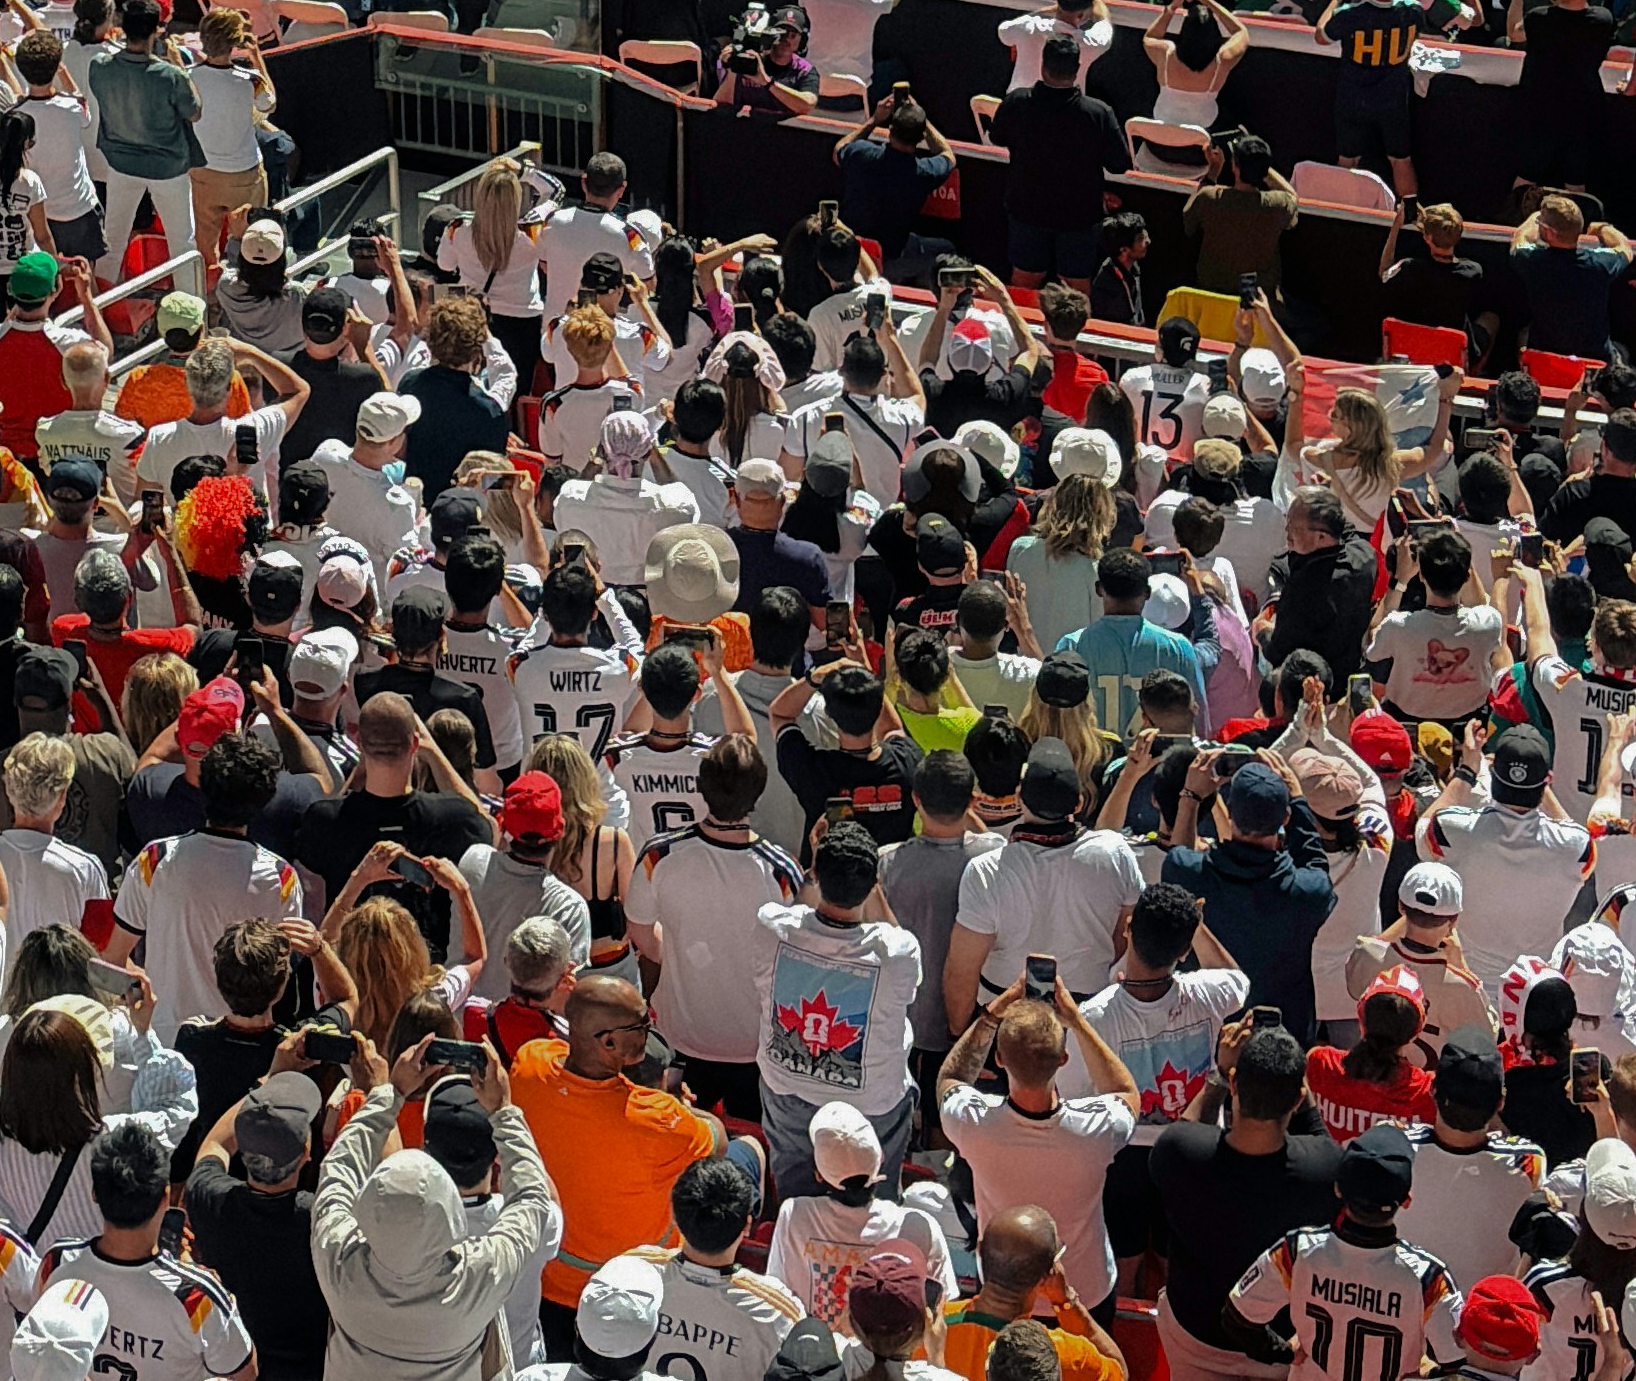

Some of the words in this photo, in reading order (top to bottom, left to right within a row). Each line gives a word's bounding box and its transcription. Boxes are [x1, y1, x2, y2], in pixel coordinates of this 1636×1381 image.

[1142, 390, 1185, 451] 13
[436, 653, 498, 676] AVERTZ
[550, 669, 603, 693] WIRTZ
[533, 702, 615, 767] 17
[632, 773, 703, 795] KIMMIC
[768, 1046, 861, 1090] CANADA
[1310, 1273, 1403, 1318] MUSIALA
[101, 1323, 165, 1361] ERTZ
[1305, 1301, 1404, 1381] 10
